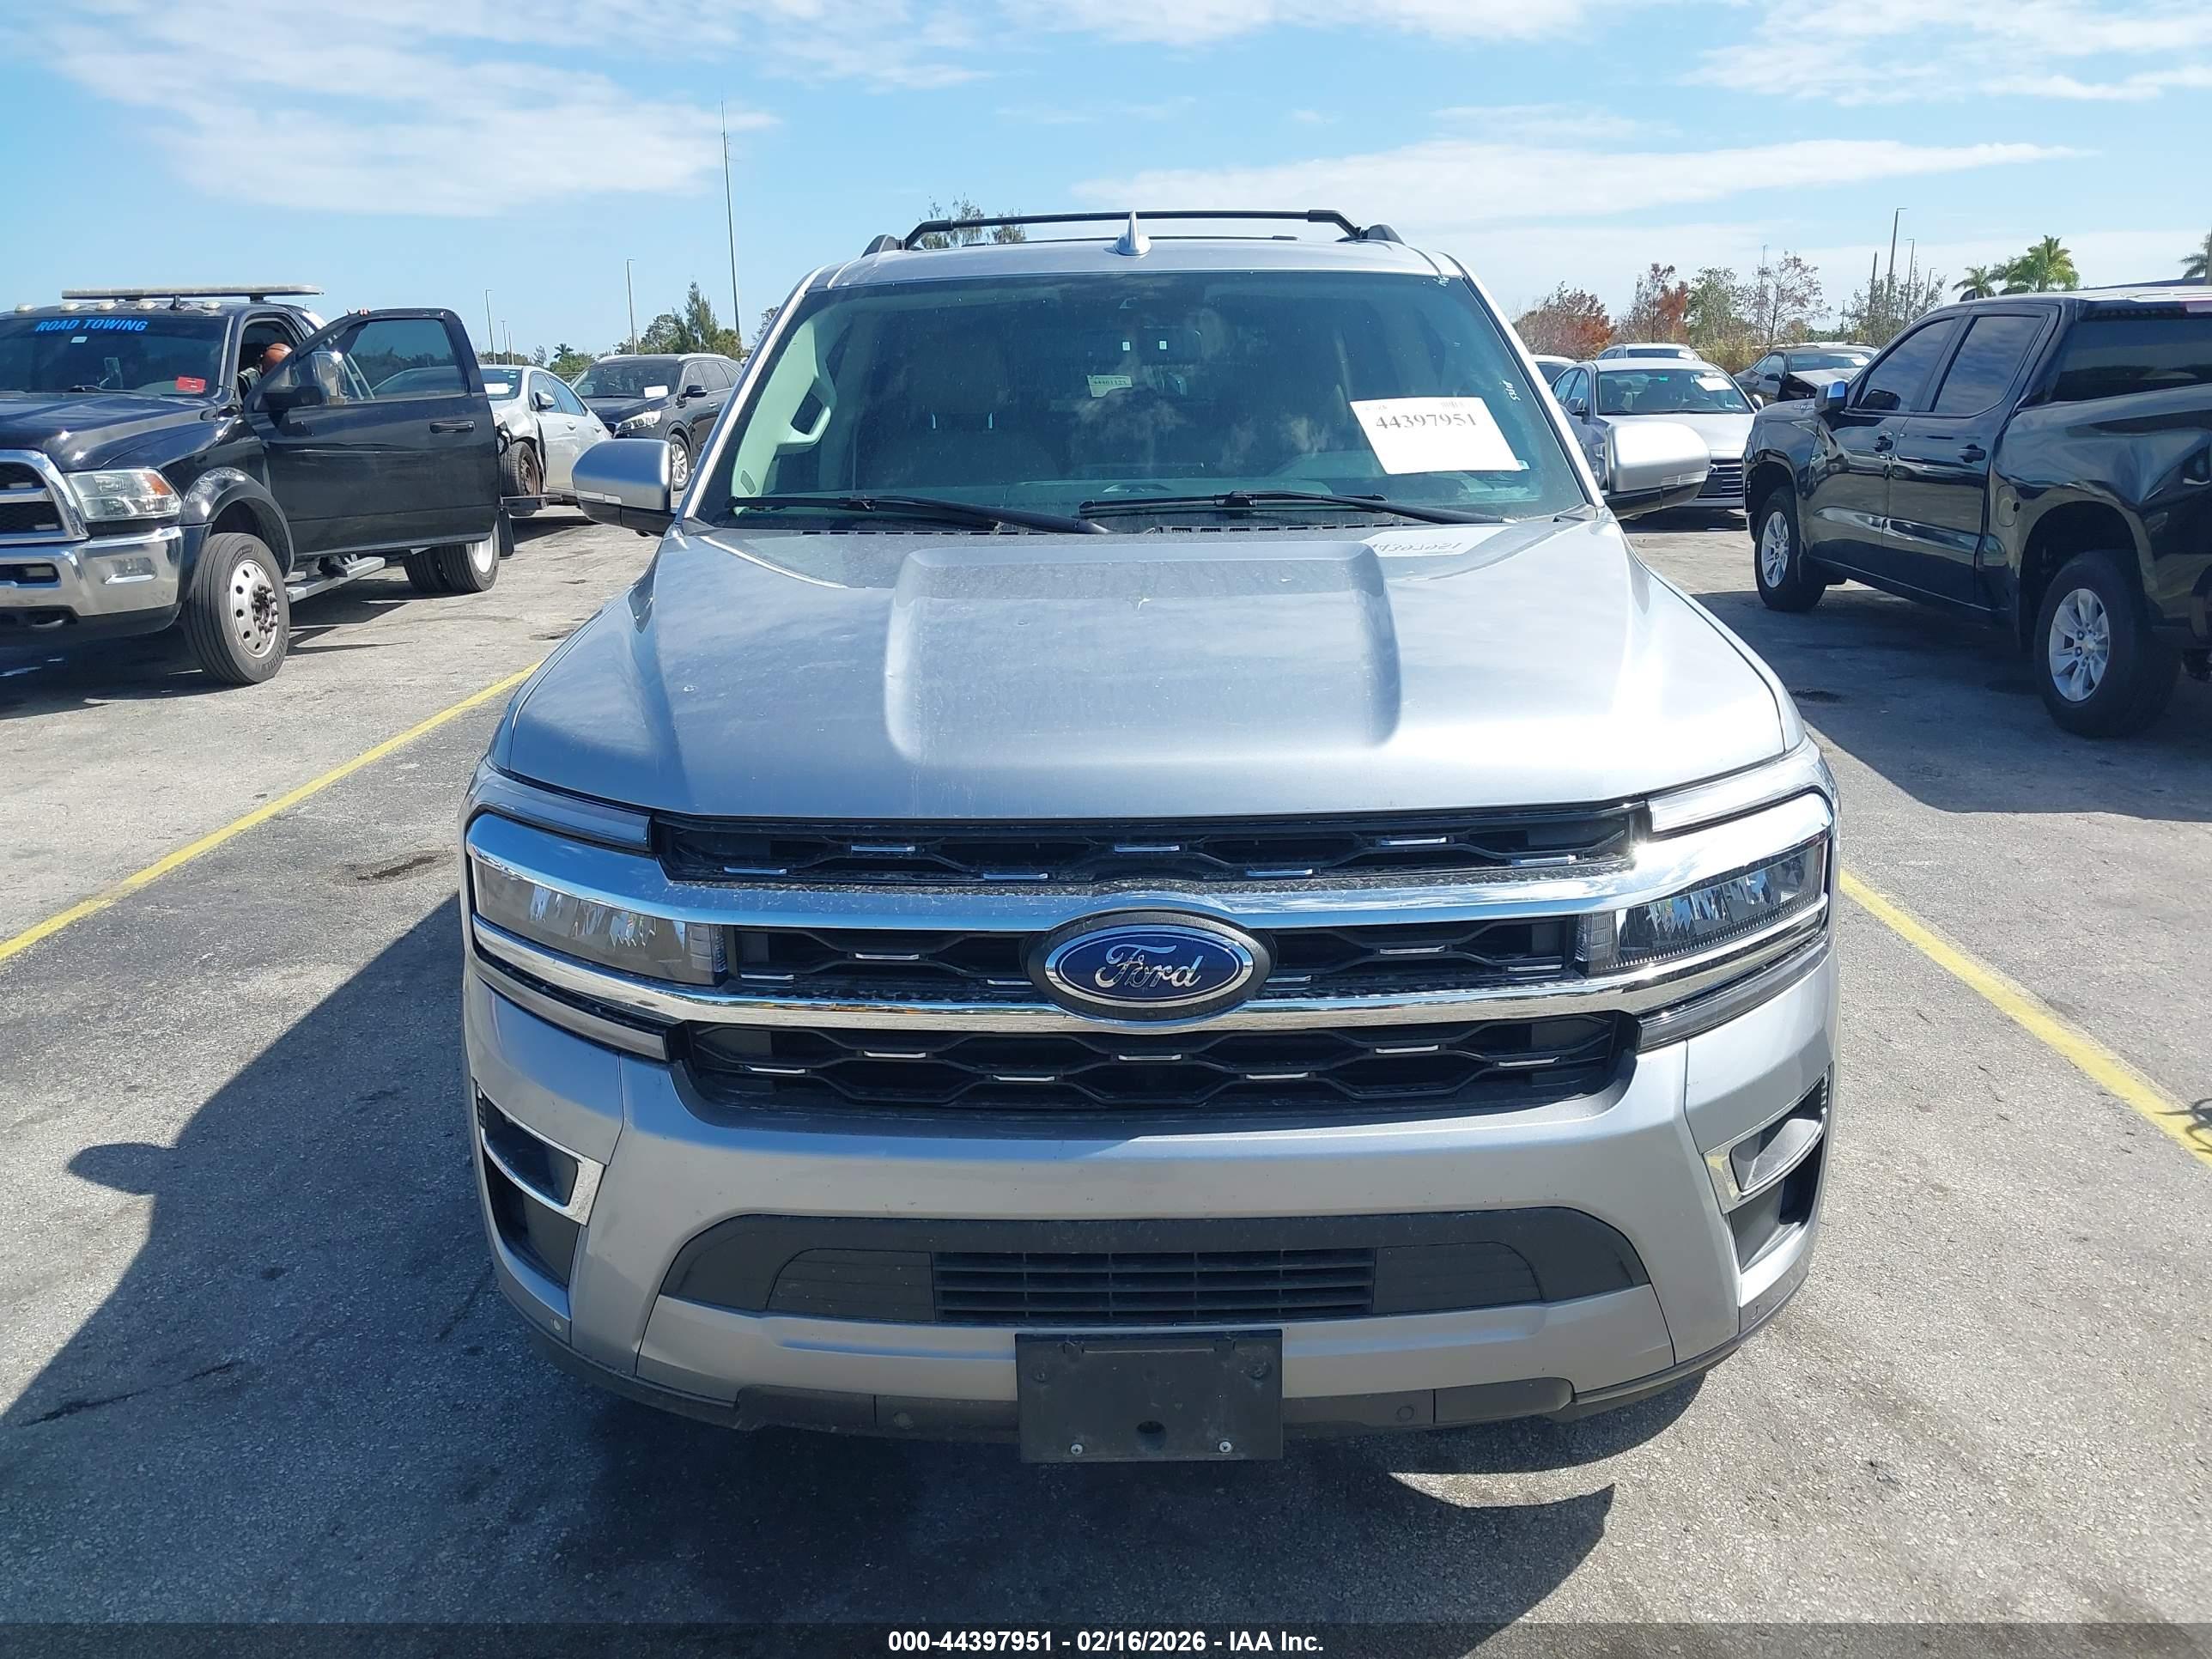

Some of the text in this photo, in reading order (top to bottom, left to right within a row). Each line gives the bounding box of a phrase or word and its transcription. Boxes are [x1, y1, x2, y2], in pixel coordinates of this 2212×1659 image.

[35, 319, 149, 331] ROAD TOWING
[1376, 414, 1477, 428] 44397951
[1095, 944, 1204, 988] Ford
